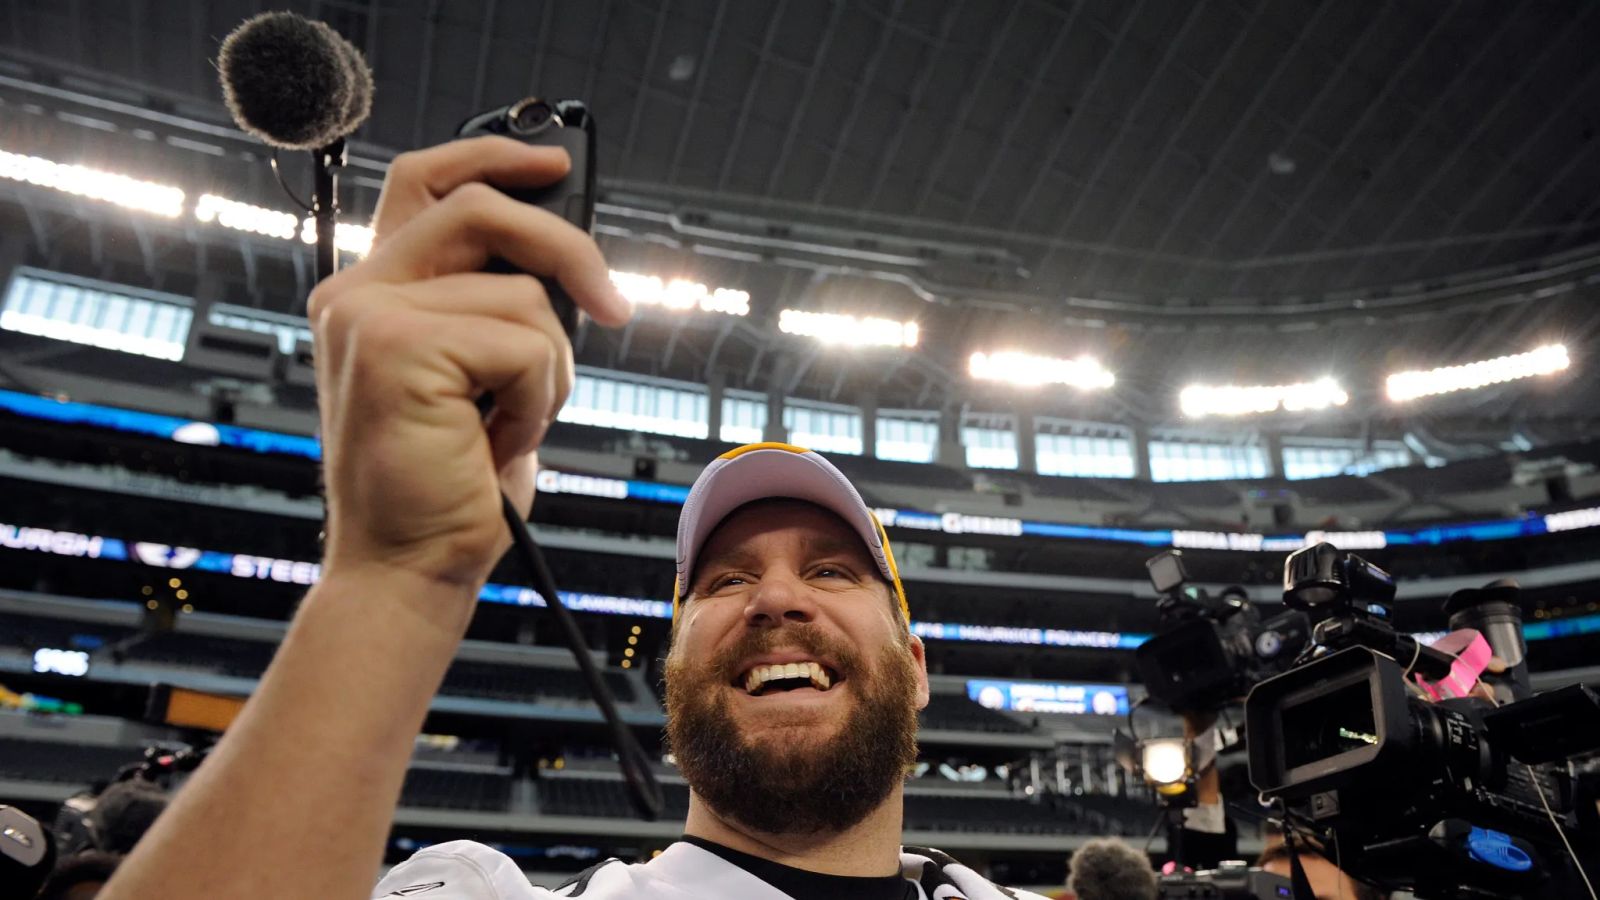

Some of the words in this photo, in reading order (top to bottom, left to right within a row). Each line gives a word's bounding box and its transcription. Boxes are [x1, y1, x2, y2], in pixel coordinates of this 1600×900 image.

[0, 522, 103, 558] URGH
[568, 593, 666, 617] LAWRENCE
[959, 625, 1041, 644] MAURICE
[1044, 628, 1120, 648] POUNCEY
